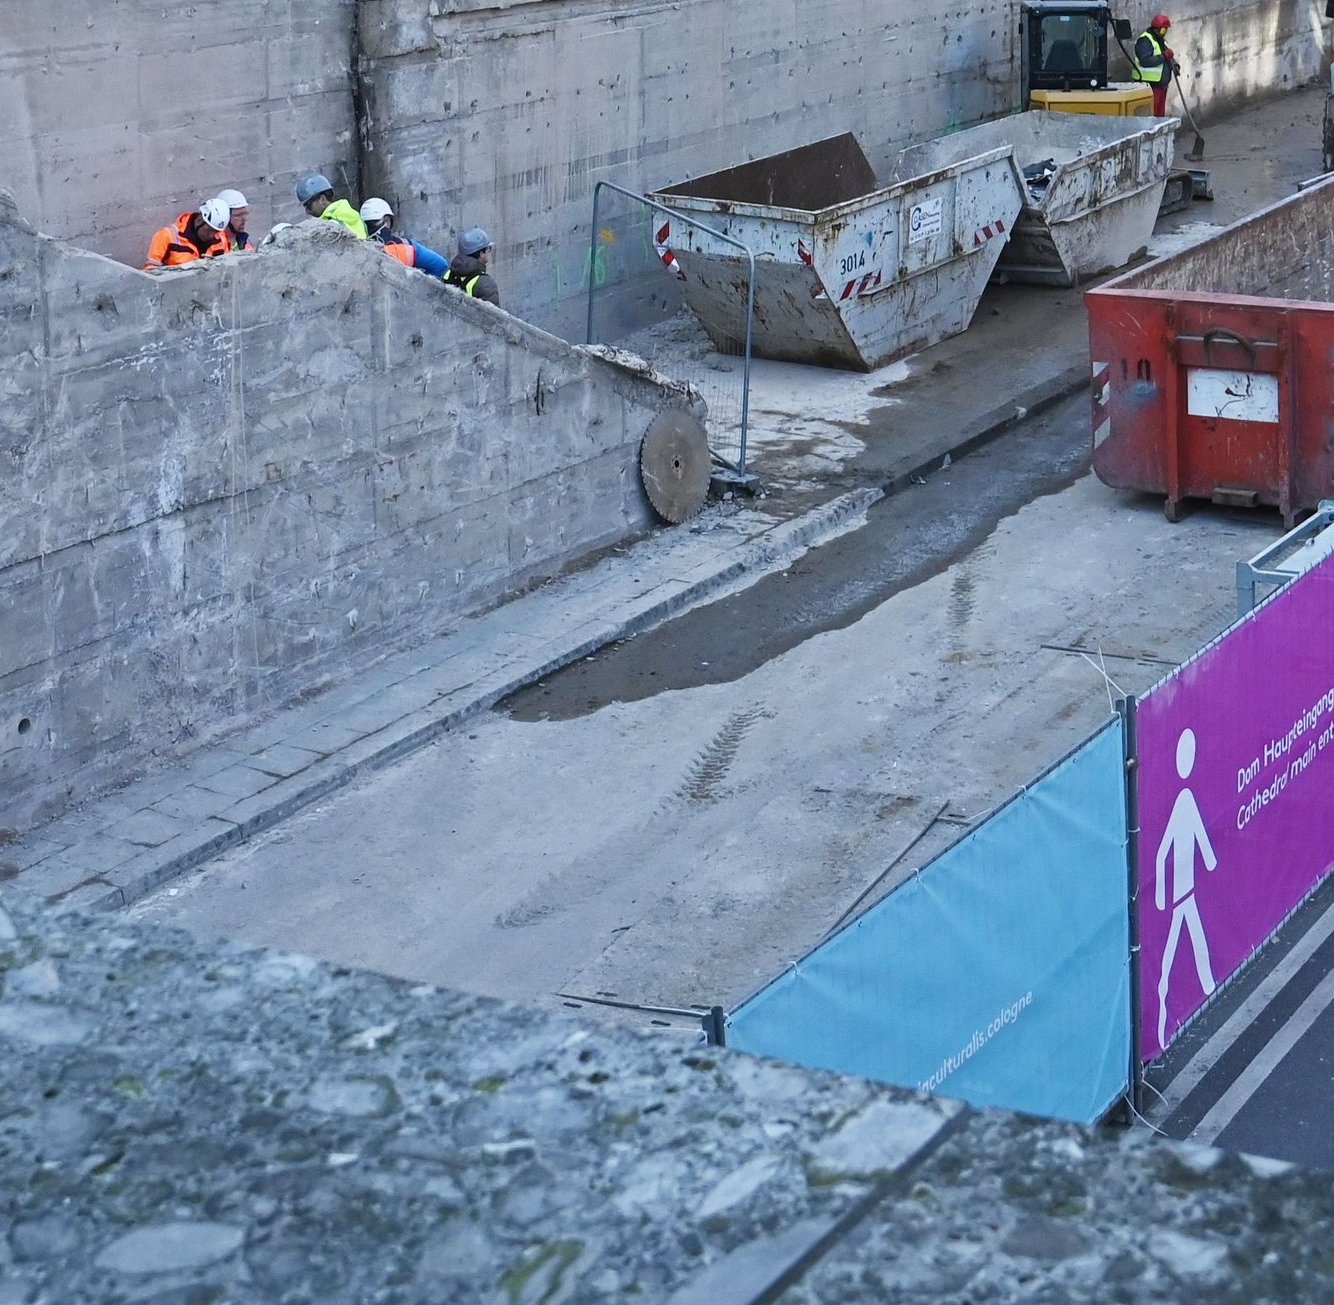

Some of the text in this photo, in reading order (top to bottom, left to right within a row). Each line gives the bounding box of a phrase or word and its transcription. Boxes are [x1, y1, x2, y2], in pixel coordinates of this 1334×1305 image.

[840, 250, 866, 275] 3014
[1237, 688, 1334, 793] Dom Haupteingang
[1237, 761, 1290, 830] Cathedral
[1290, 740, 1316, 780] main
[917, 991, 1033, 1092] iaculturalis.cologne
